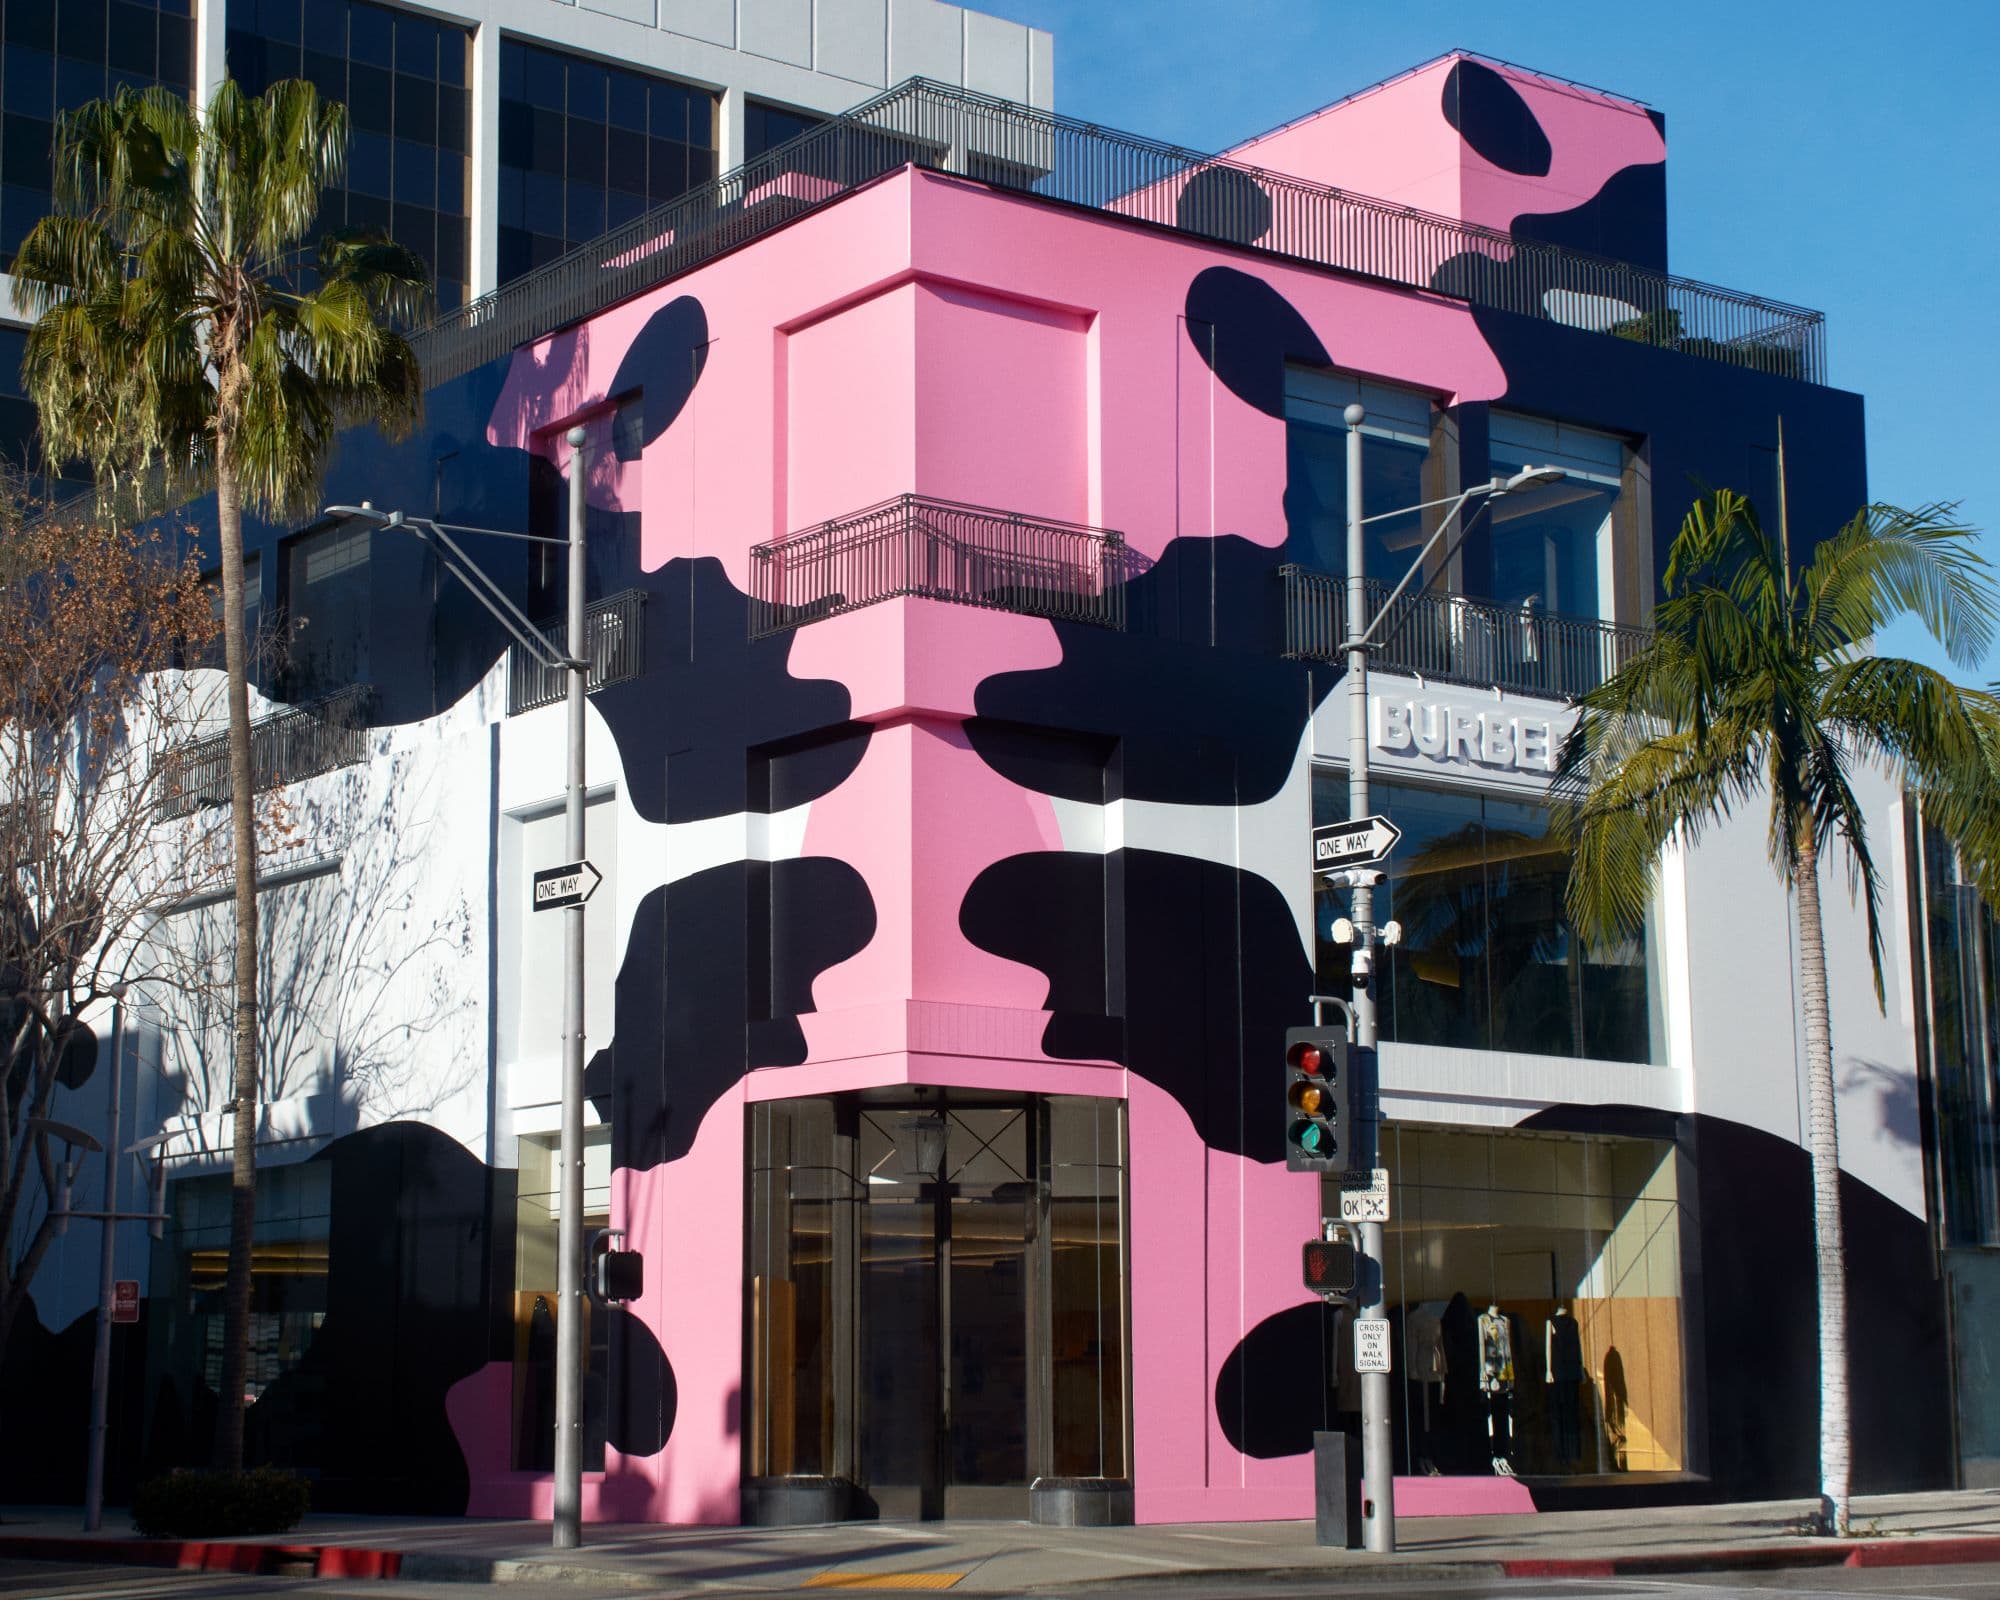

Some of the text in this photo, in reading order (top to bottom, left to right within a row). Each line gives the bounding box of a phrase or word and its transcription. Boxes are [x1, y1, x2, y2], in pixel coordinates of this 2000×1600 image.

[1319, 832, 1369, 857] ONE WAY
[538, 876, 579, 899] ONE WAY
[1343, 1171, 1384, 1182] DIAGONAL
[1343, 1183, 1386, 1193] CROSSING
[1343, 1200, 1360, 1216] OK
[1359, 1324, 1385, 1332] CROSS
[1362, 1350, 1383, 1358] WALK
[1359, 1359, 1386, 1367] SIGNAL
